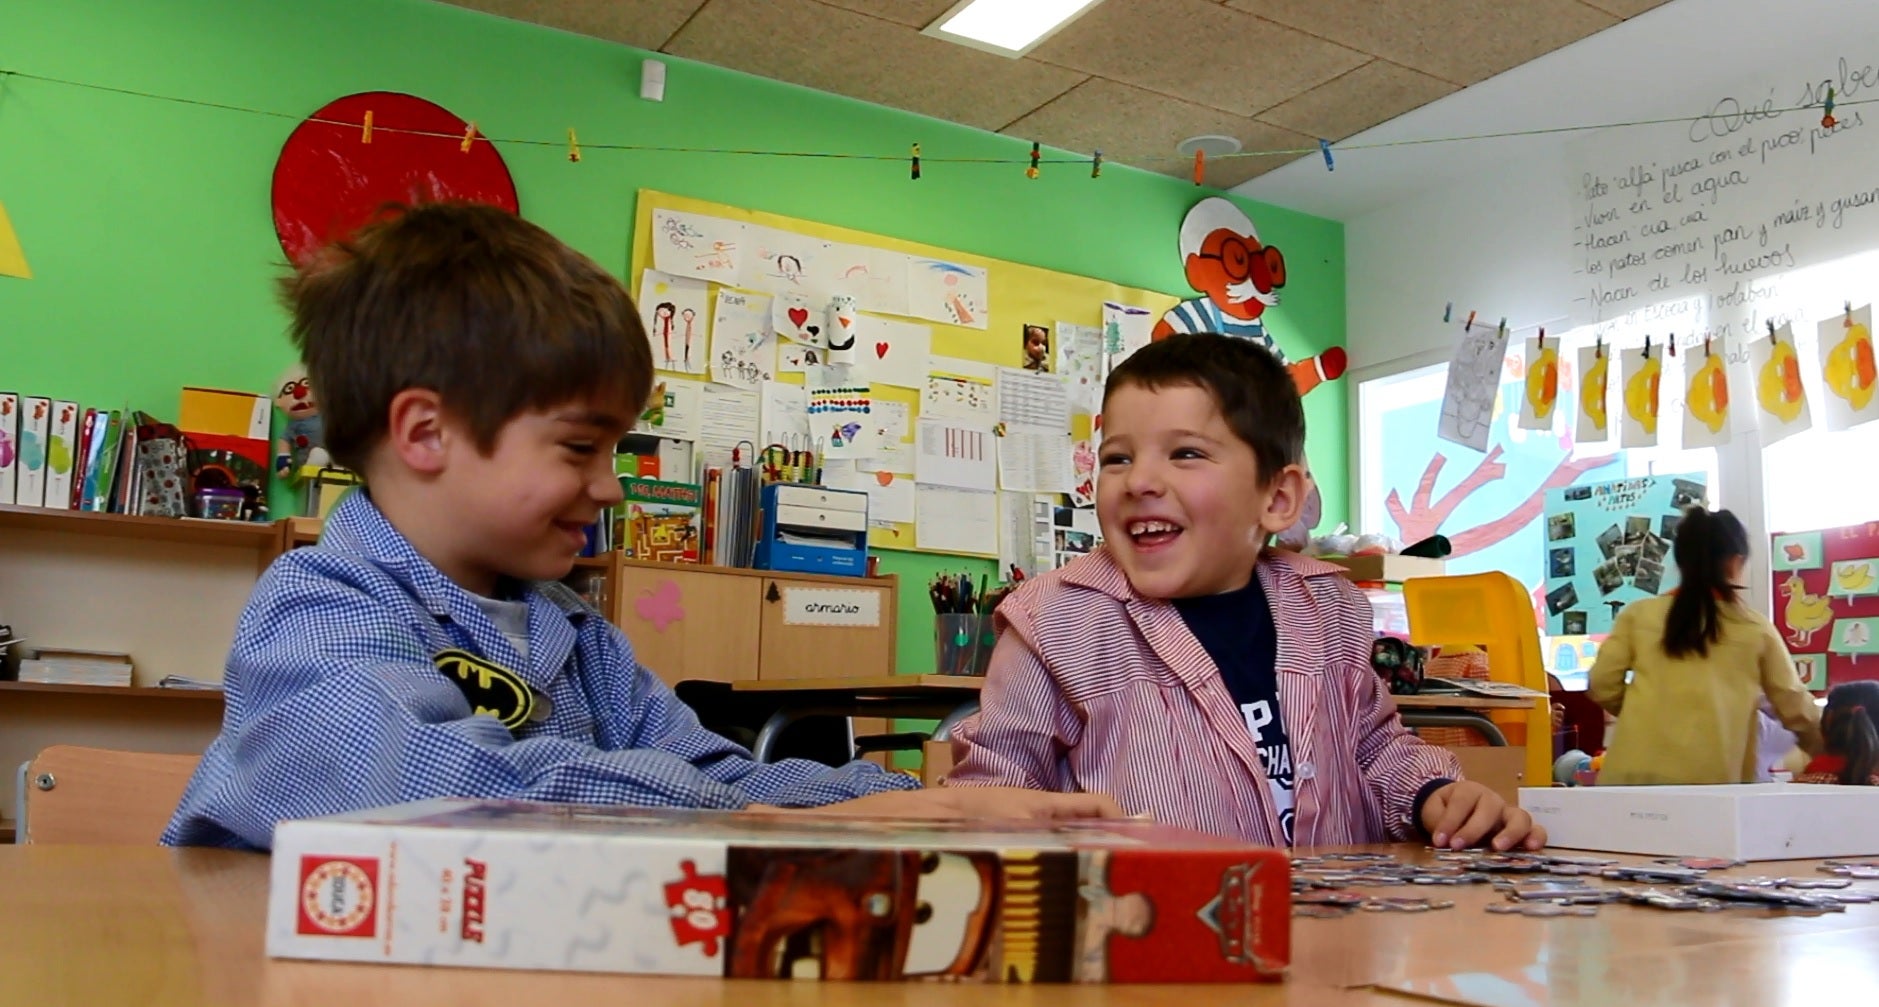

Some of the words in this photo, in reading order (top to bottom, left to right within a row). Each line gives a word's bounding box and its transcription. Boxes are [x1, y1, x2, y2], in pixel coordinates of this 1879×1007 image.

[1796, 57, 1879, 108] sabe
[1629, 200, 1652, 213] en
[1663, 184, 1683, 203] el
[1691, 170, 1748, 205] agua
[1609, 251, 1646, 279] patos
[1654, 236, 1704, 260] comen
[1714, 225, 1753, 261] pan
[1759, 223, 1768, 247] y
[1816, 202, 1826, 229] y
[1648, 272, 1670, 292] de
[1715, 243, 1795, 275] huevos
[805, 602, 860, 614] armario
[462, 857, 487, 944] PUZZLE
[683, 887, 719, 931] 80
